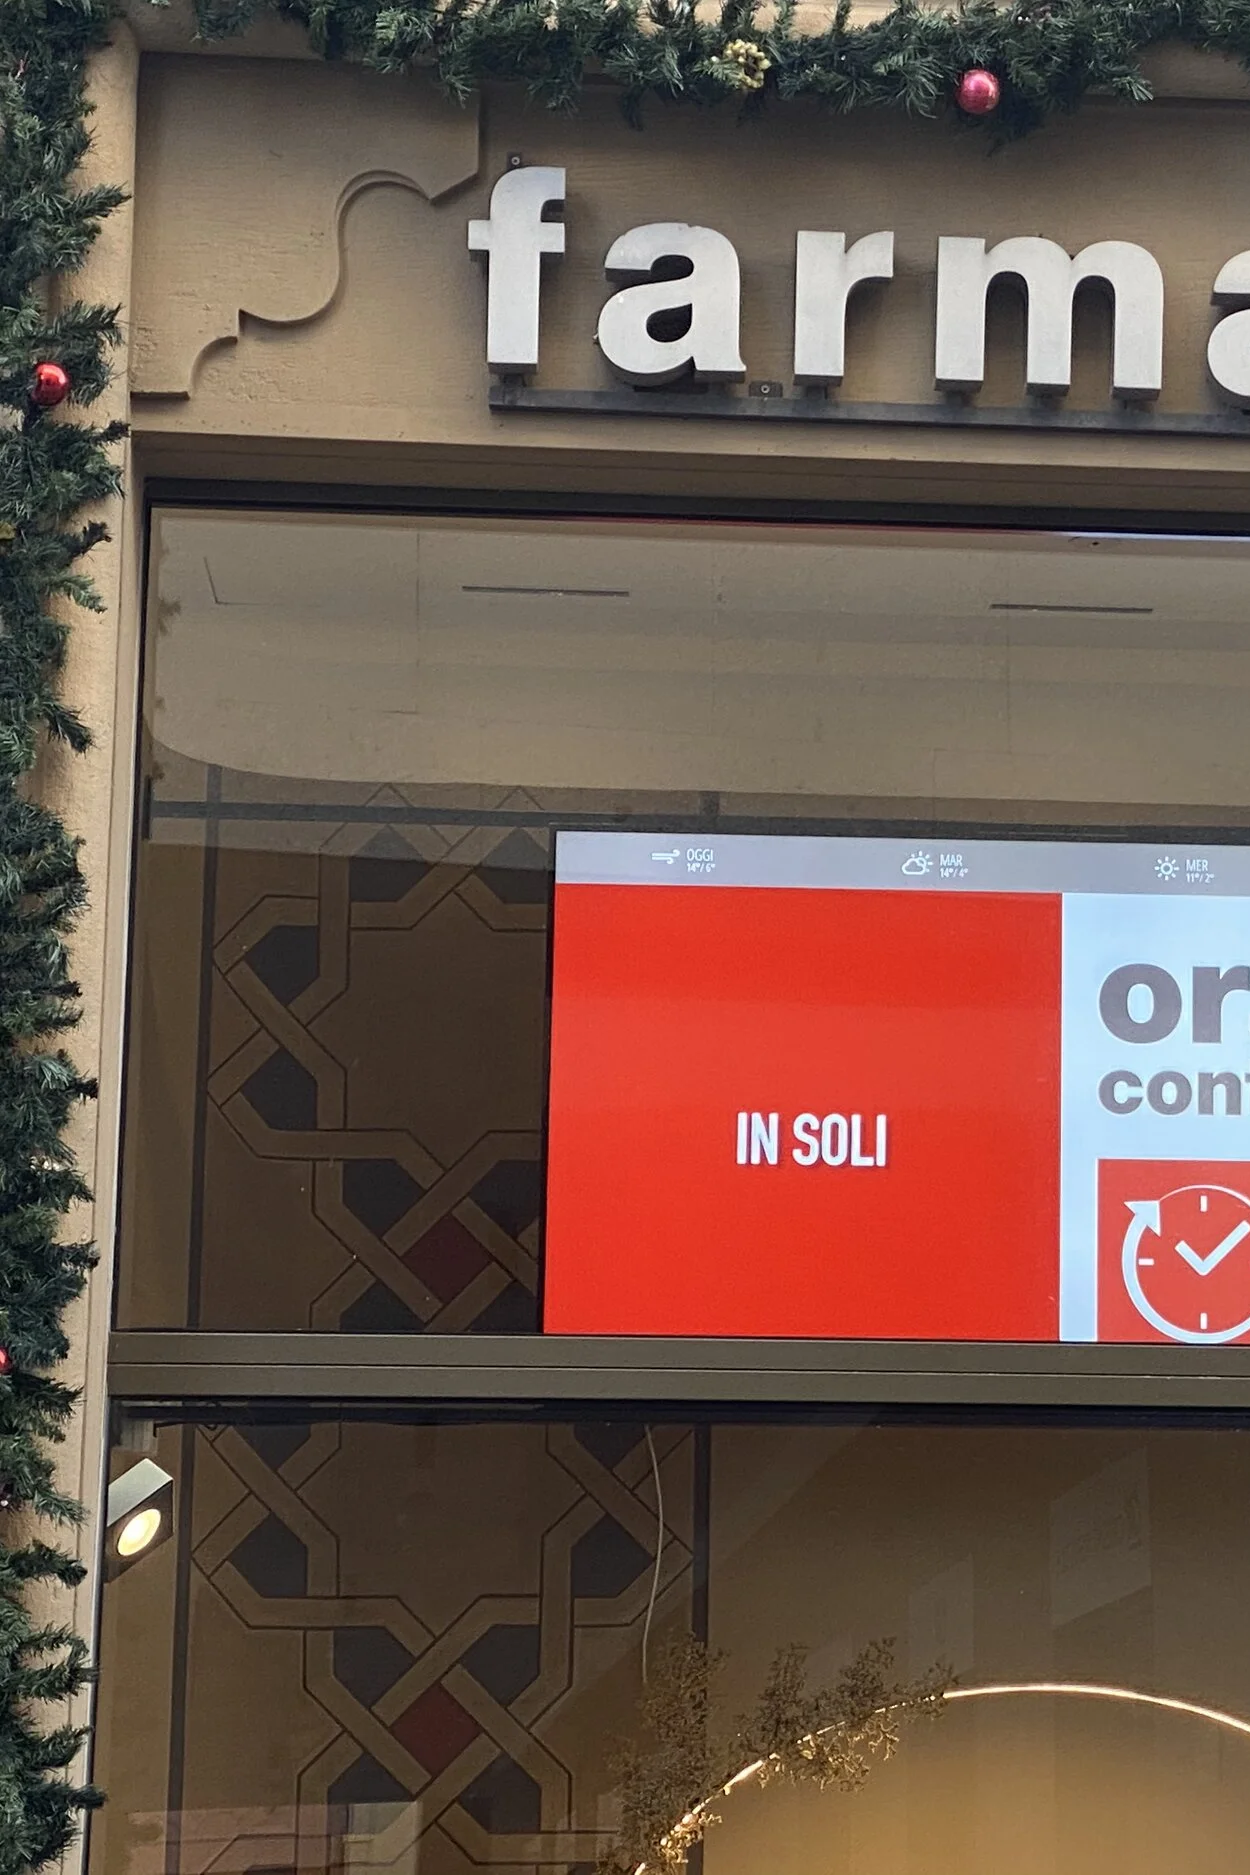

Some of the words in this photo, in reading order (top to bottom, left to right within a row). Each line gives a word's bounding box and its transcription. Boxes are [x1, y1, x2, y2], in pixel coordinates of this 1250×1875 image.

[686, 848, 714, 862] OGGI
[939, 854, 963, 867] MAR
[1185, 859, 1209, 872] MER
[736, 1111, 780, 1166] IN
[792, 1112, 888, 1168] SOLI
